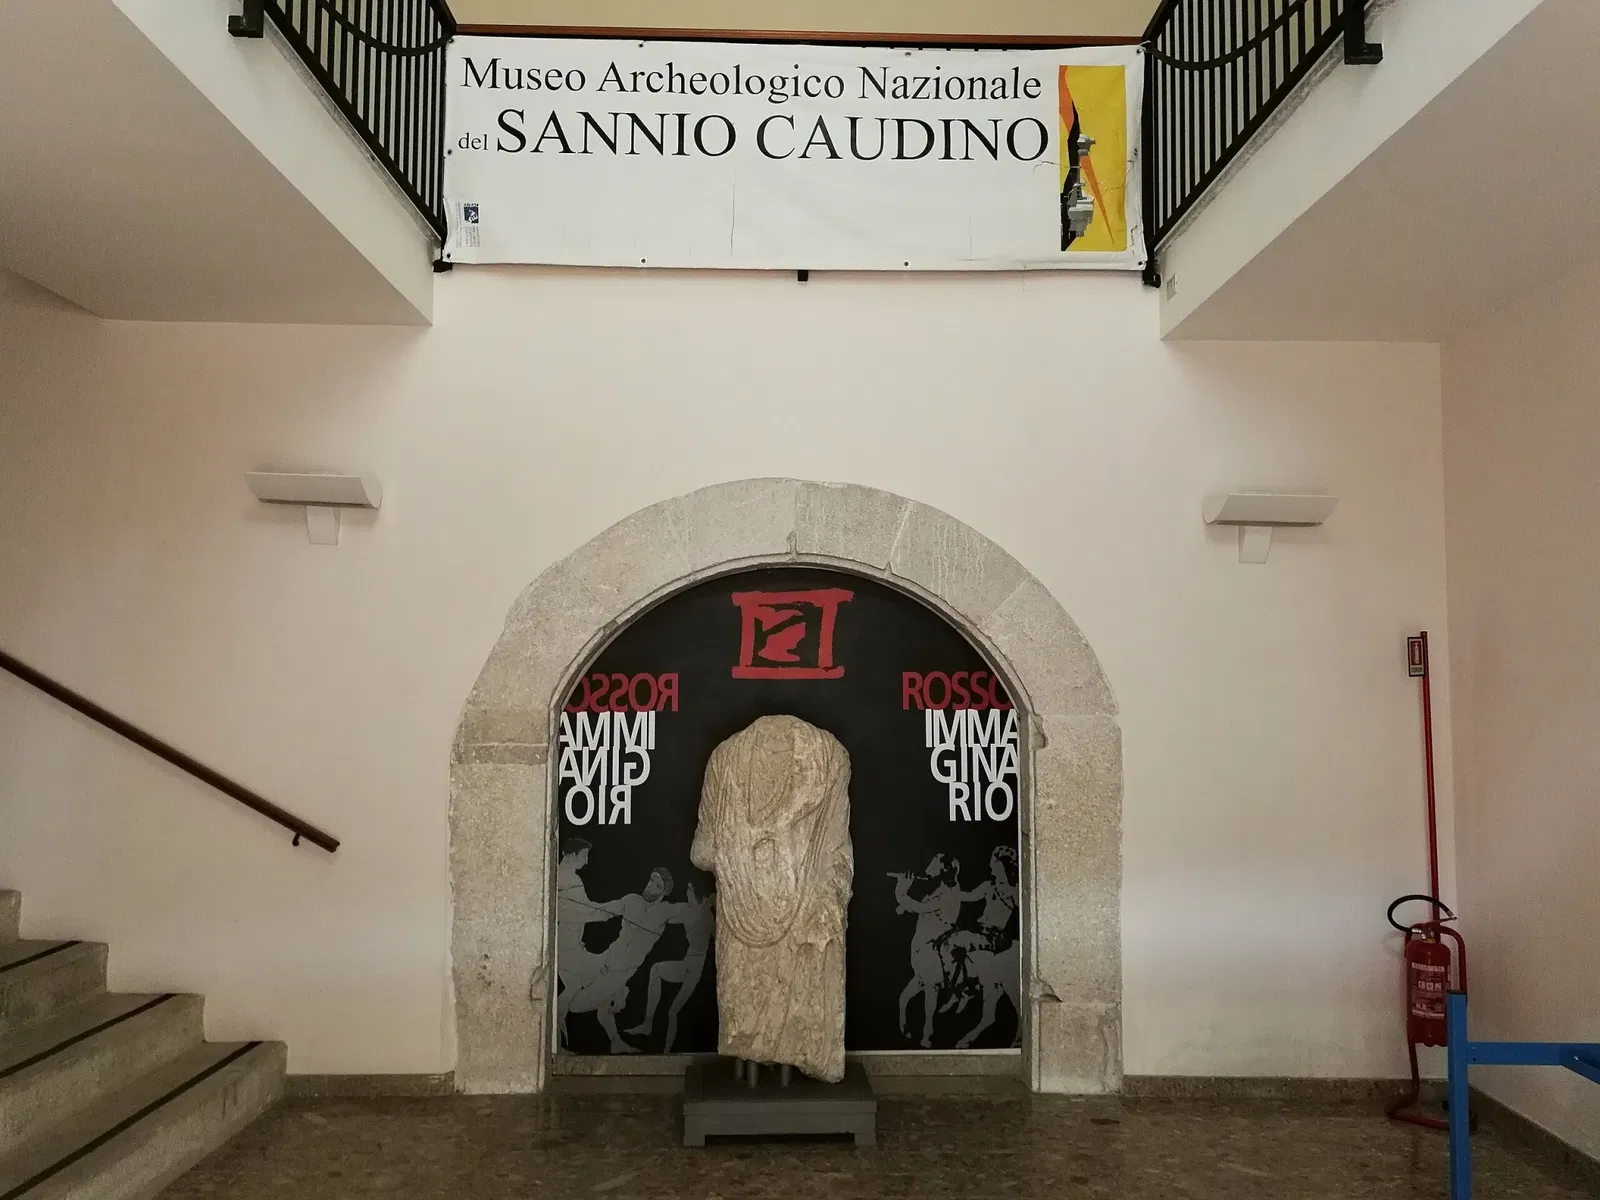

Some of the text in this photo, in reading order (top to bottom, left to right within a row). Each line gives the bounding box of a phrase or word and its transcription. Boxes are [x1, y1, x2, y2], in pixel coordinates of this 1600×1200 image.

[460, 57, 1042, 104] Museo Archeologico Nazionale
[458, 108, 1049, 161] del SANNIO CAUDINO
[925, 708, 1020, 748] IMMA
[930, 742, 1020, 783] GINA
[949, 781, 1014, 822] RIO
